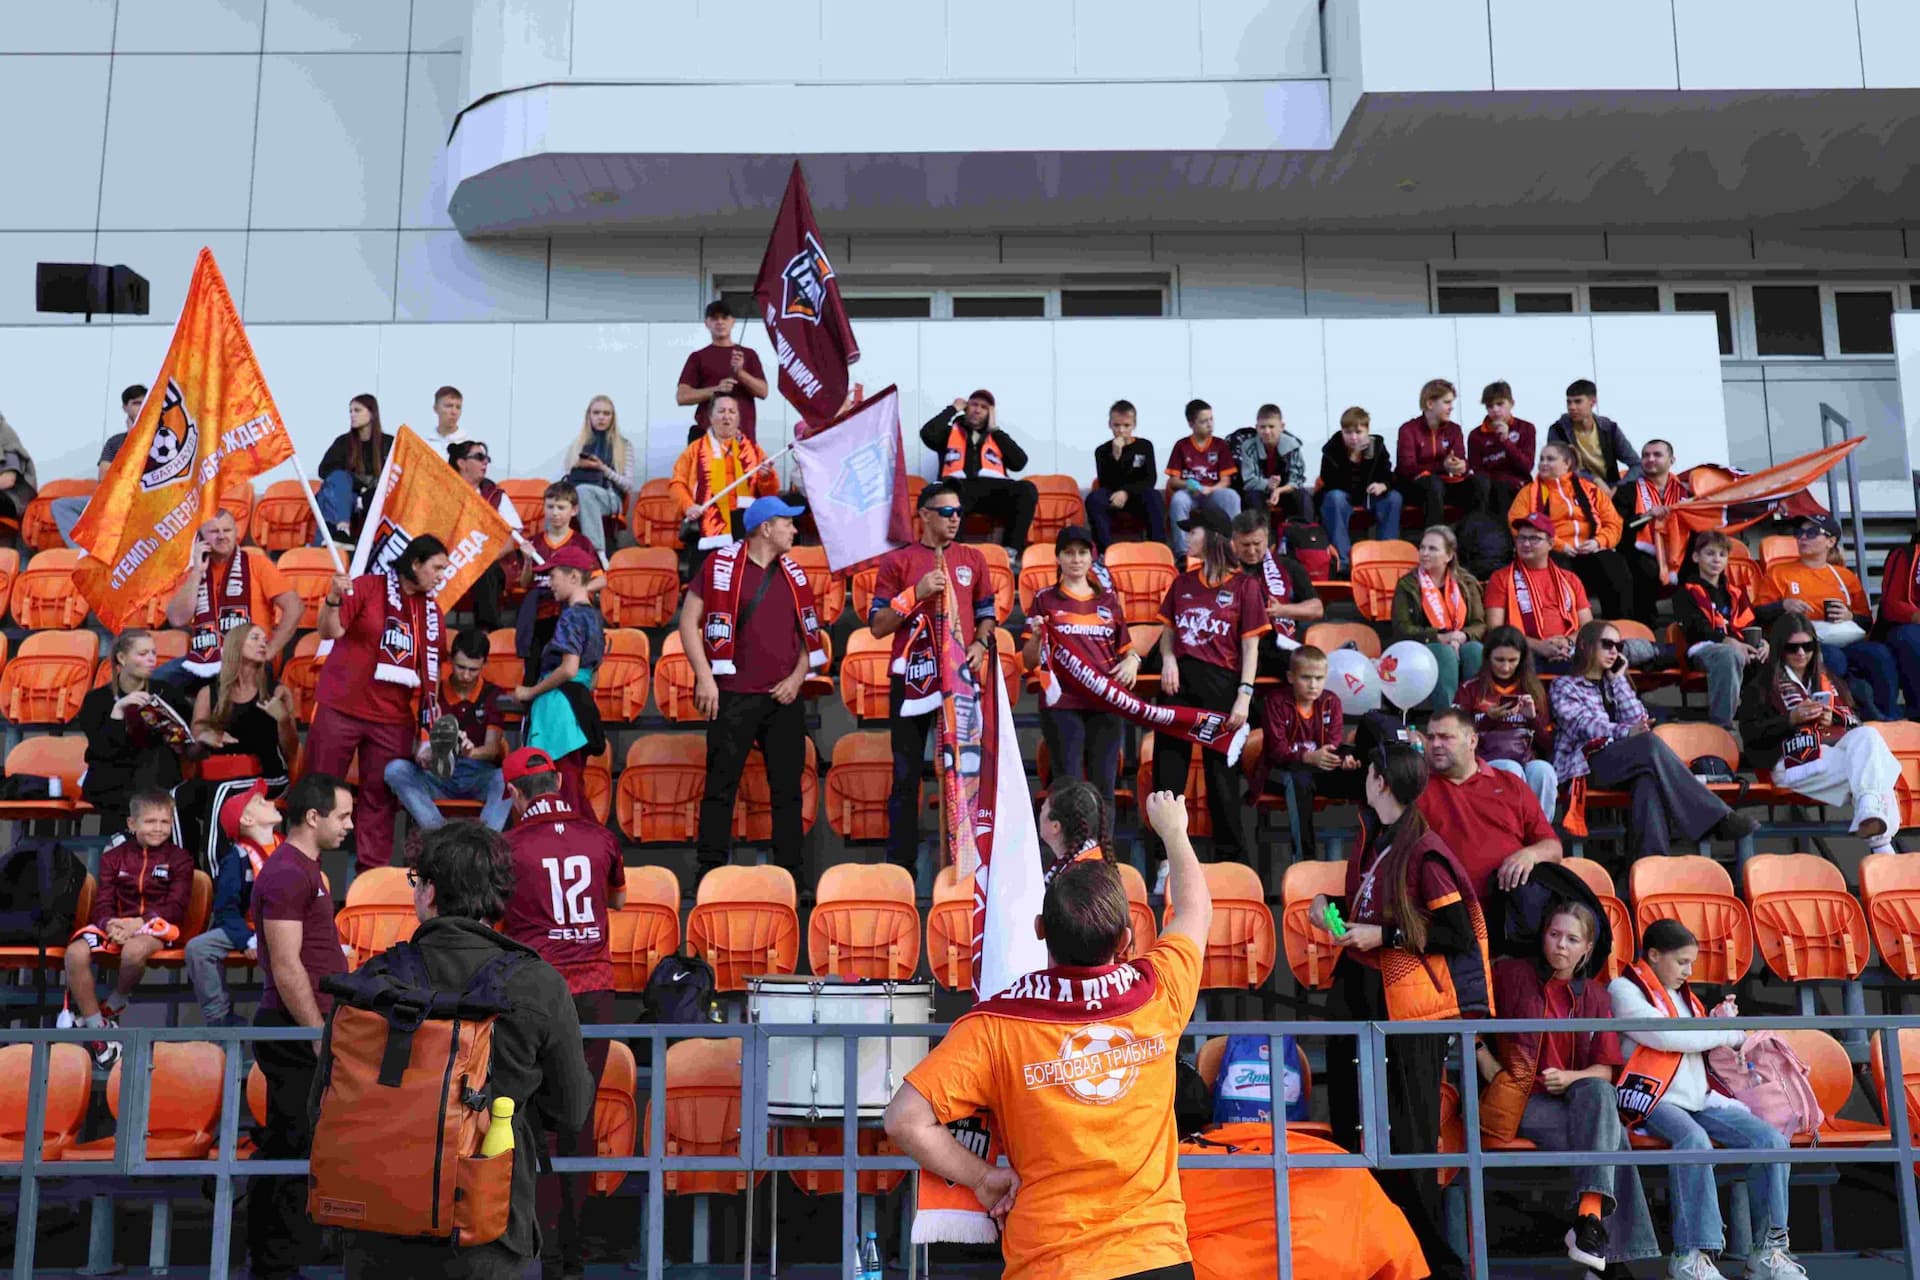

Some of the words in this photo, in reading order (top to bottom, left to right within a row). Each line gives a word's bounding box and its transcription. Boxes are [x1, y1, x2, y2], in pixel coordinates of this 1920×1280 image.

[192, 633, 218, 650] ТЕМП
[908, 660, 935, 680] ТЕМП
[1105, 685, 1141, 715] КЛУБ
[1785, 735, 1814, 754] ТЕМП
[541, 855, 596, 926] 12
[1023, 1054, 1102, 1086] БОРДОВАЯ
[1103, 1038, 1167, 1067] ТРИБУНА
[1618, 1088, 1652, 1112] ТЕМП
